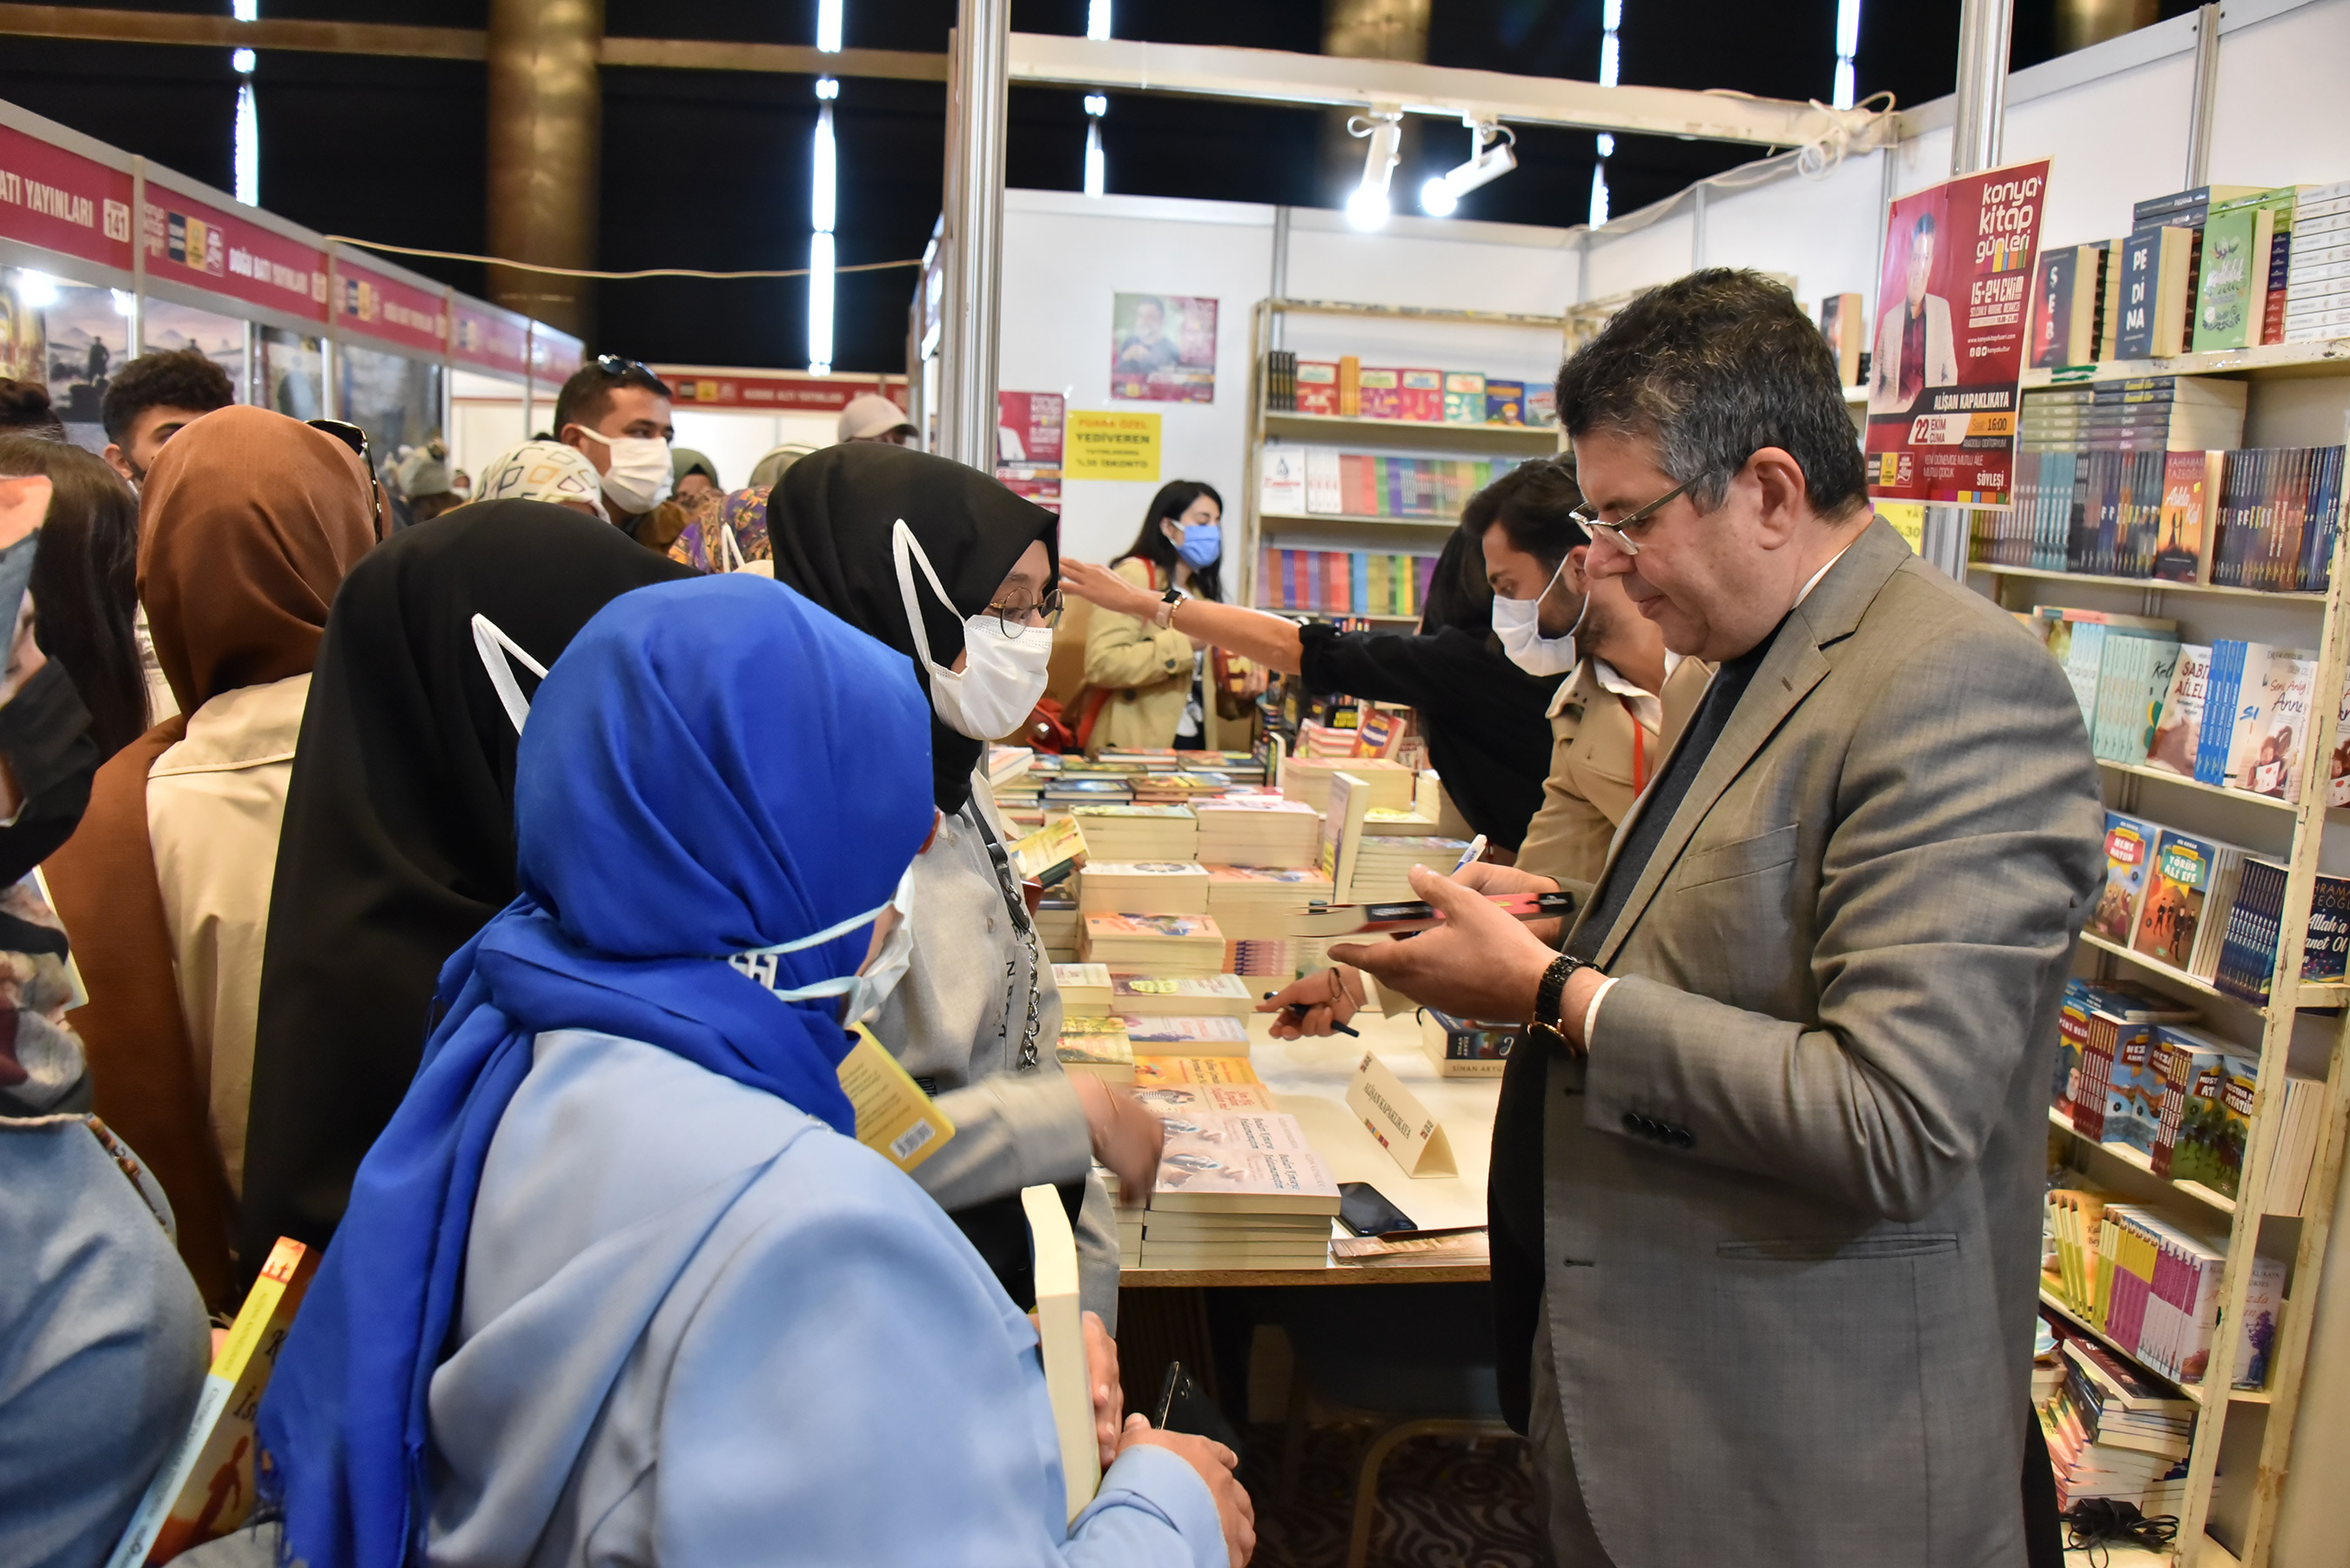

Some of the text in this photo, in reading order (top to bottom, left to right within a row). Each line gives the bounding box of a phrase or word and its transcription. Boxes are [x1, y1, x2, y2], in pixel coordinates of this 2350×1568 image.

[25, 178, 93, 228] YAYINLARI
[1982, 177, 2037, 206] konya
[1978, 204, 2033, 236] kitap
[1976, 229, 2031, 264] günleri
[1971, 278, 2001, 305] 15-24
[1933, 391, 2009, 412] ALİŞAN KAPAKLIKAYA
[1915, 415, 1946, 443] 22 EKİM
[1987, 418, 2007, 431] 16:00
[1930, 433, 1945, 443] CUMA
[1977, 470, 2004, 490] SÖYLEŞİ
[2175, 678, 2206, 700] AİLEL
[2181, 870, 2197, 883] EFE
